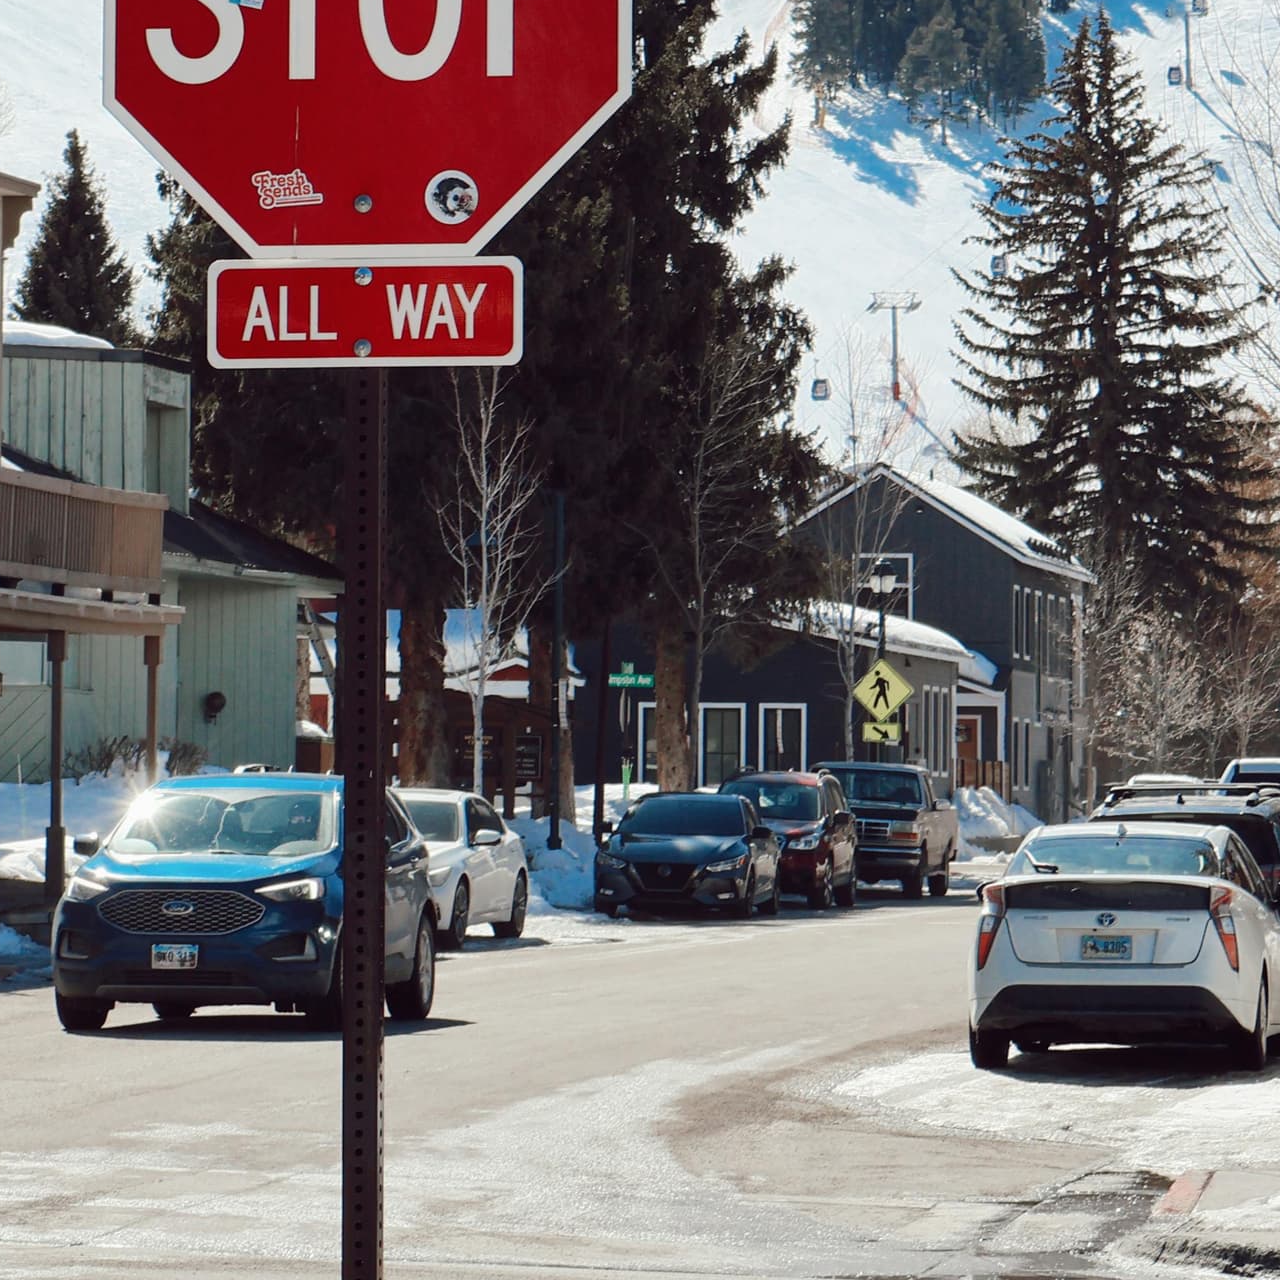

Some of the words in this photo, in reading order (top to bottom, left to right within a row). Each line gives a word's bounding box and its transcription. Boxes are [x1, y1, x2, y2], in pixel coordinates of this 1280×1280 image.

[254, 170, 305, 191] Fresh
[262, 184, 311, 206] Sends
[241, 285, 338, 342] ALL
[386, 282, 487, 340] WAY
